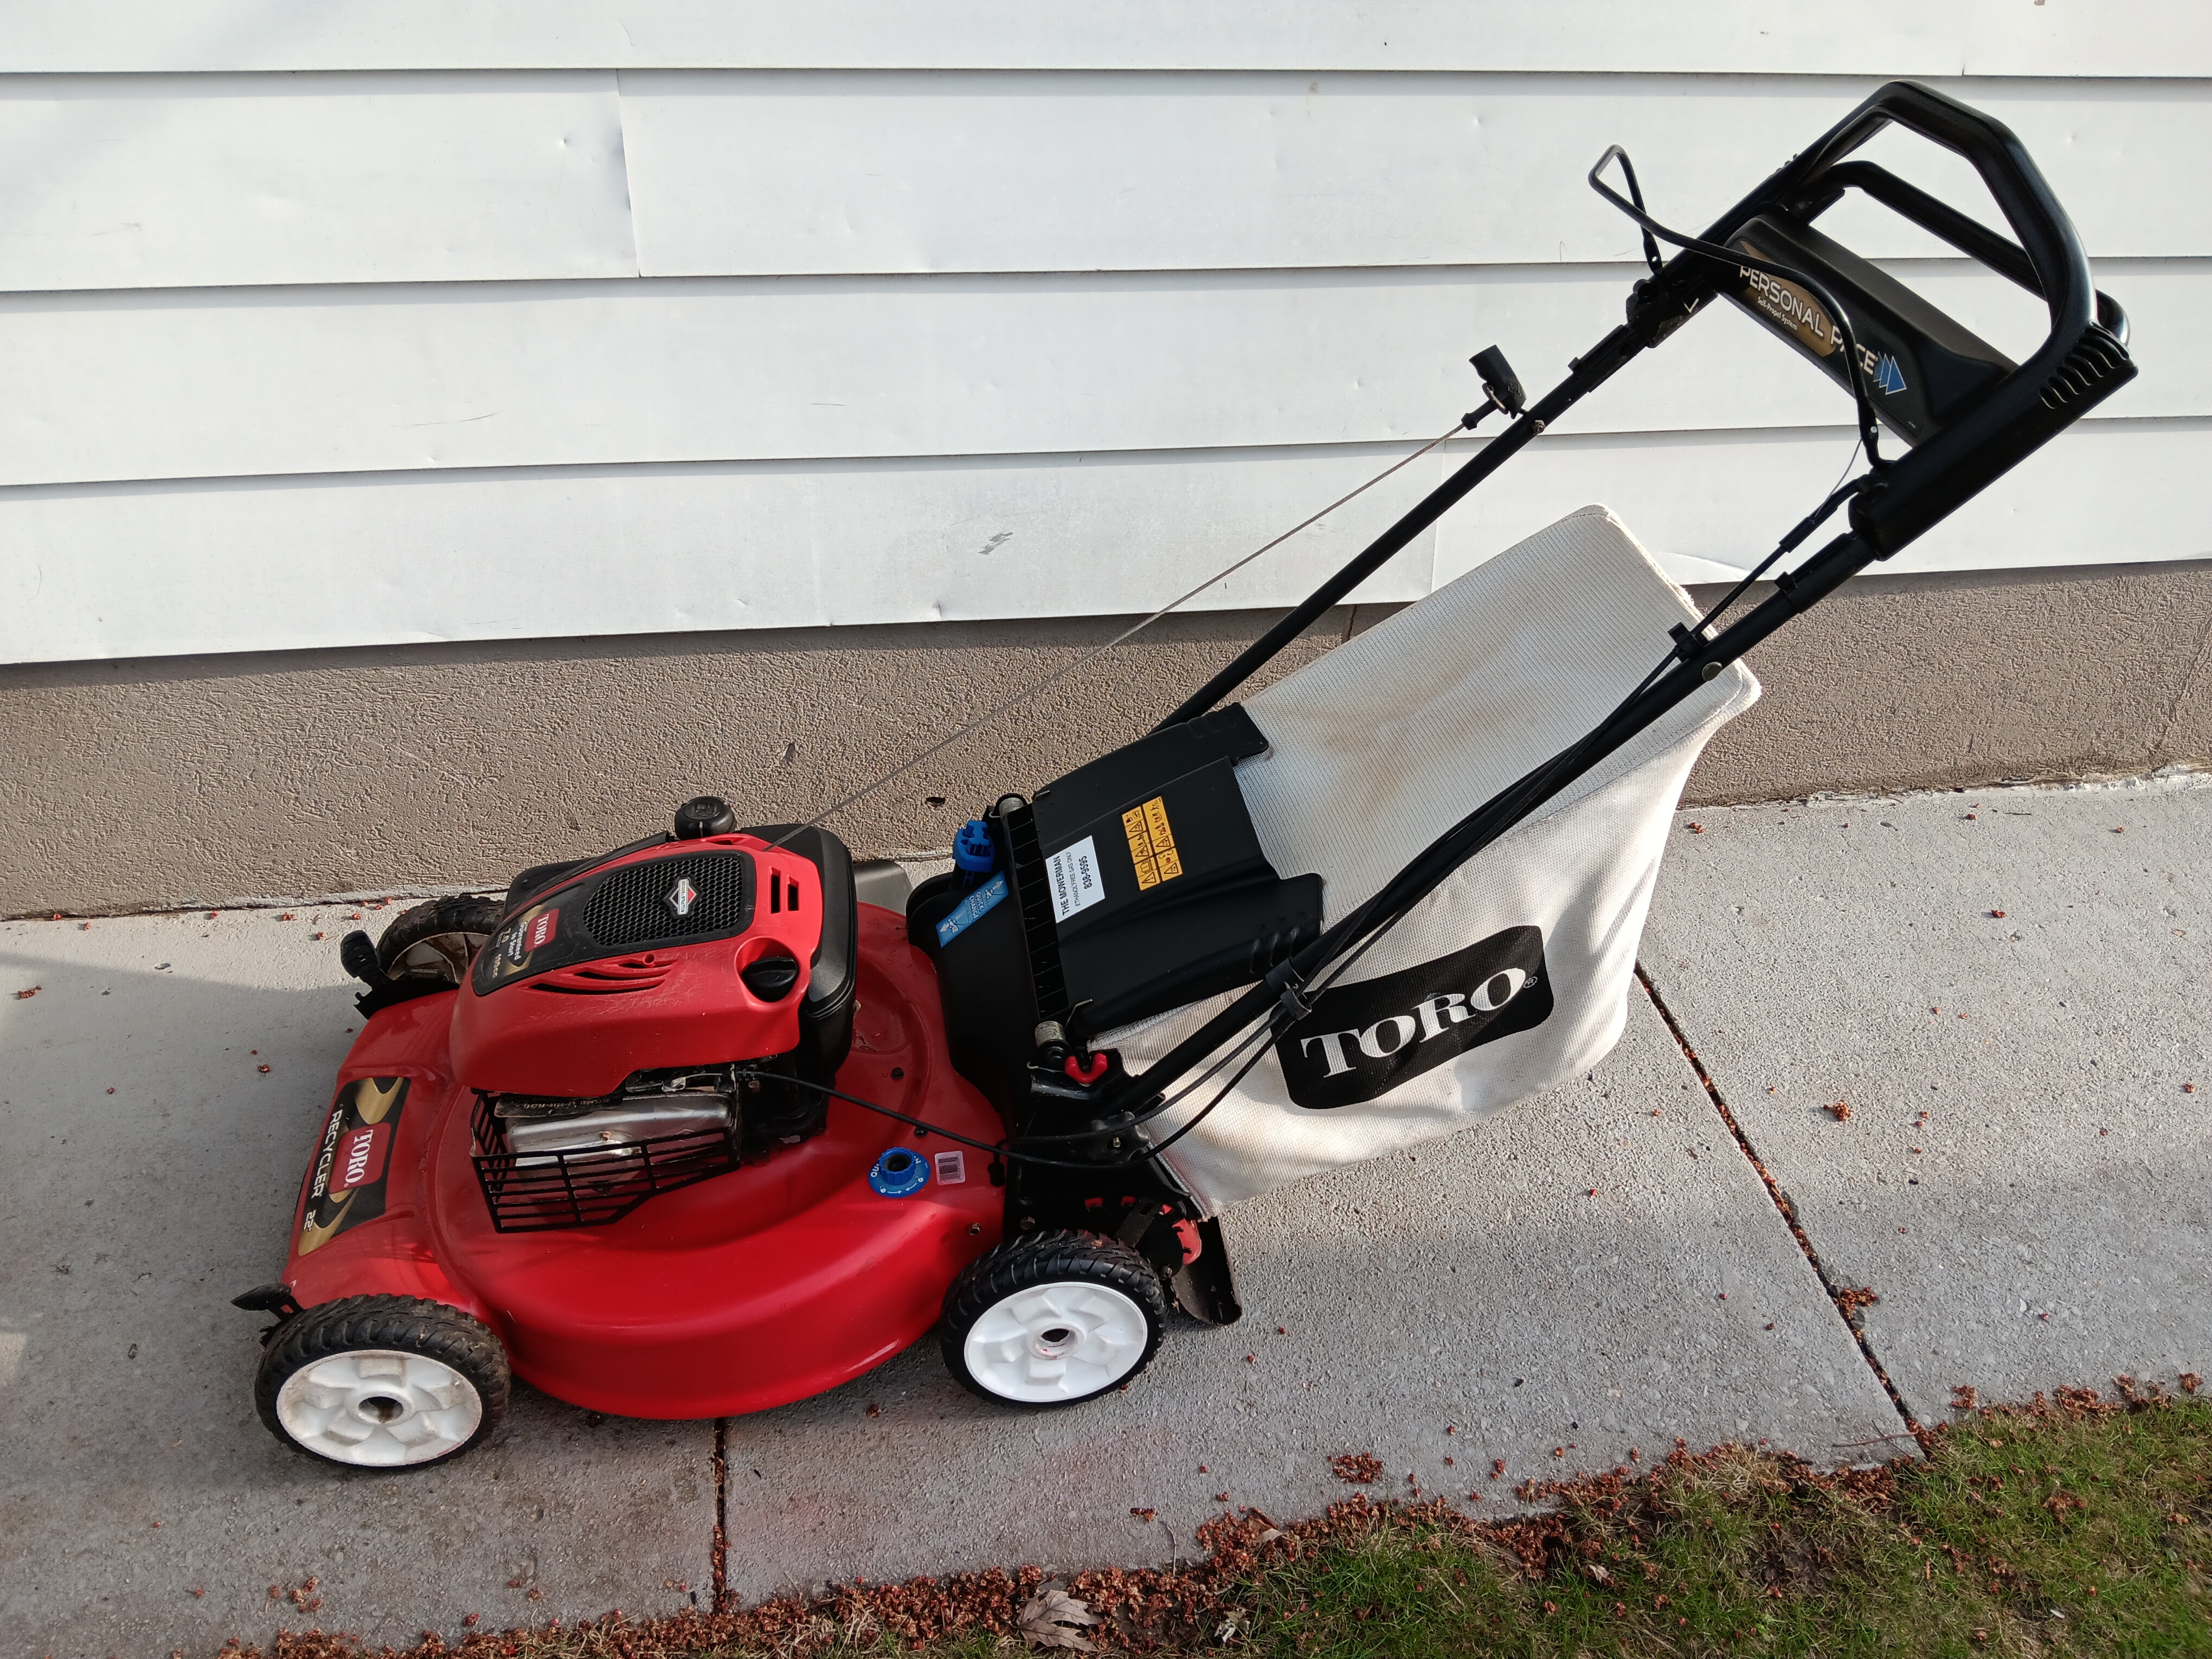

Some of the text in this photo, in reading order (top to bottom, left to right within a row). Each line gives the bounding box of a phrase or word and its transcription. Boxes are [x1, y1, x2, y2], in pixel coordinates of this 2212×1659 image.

[1739, 266, 1875, 375] PERSONAL PCE
[1758, 296, 1797, 331] Self-Propel System
[1053, 856, 1070, 916] THE MOWERMAN
[1078, 856, 1092, 889] 838-9595
[969, 895, 979, 919] CHANGE
[1071, 885, 1081, 906] ETHANOL
[514, 921, 528, 961] Guaranteed
[534, 914, 549, 944] TORO
[507, 941, 517, 957] Start
[1300, 967, 1526, 1078] TORO
[311, 1109, 343, 1199] RECYCLER
[345, 1129, 374, 1184] TORO
